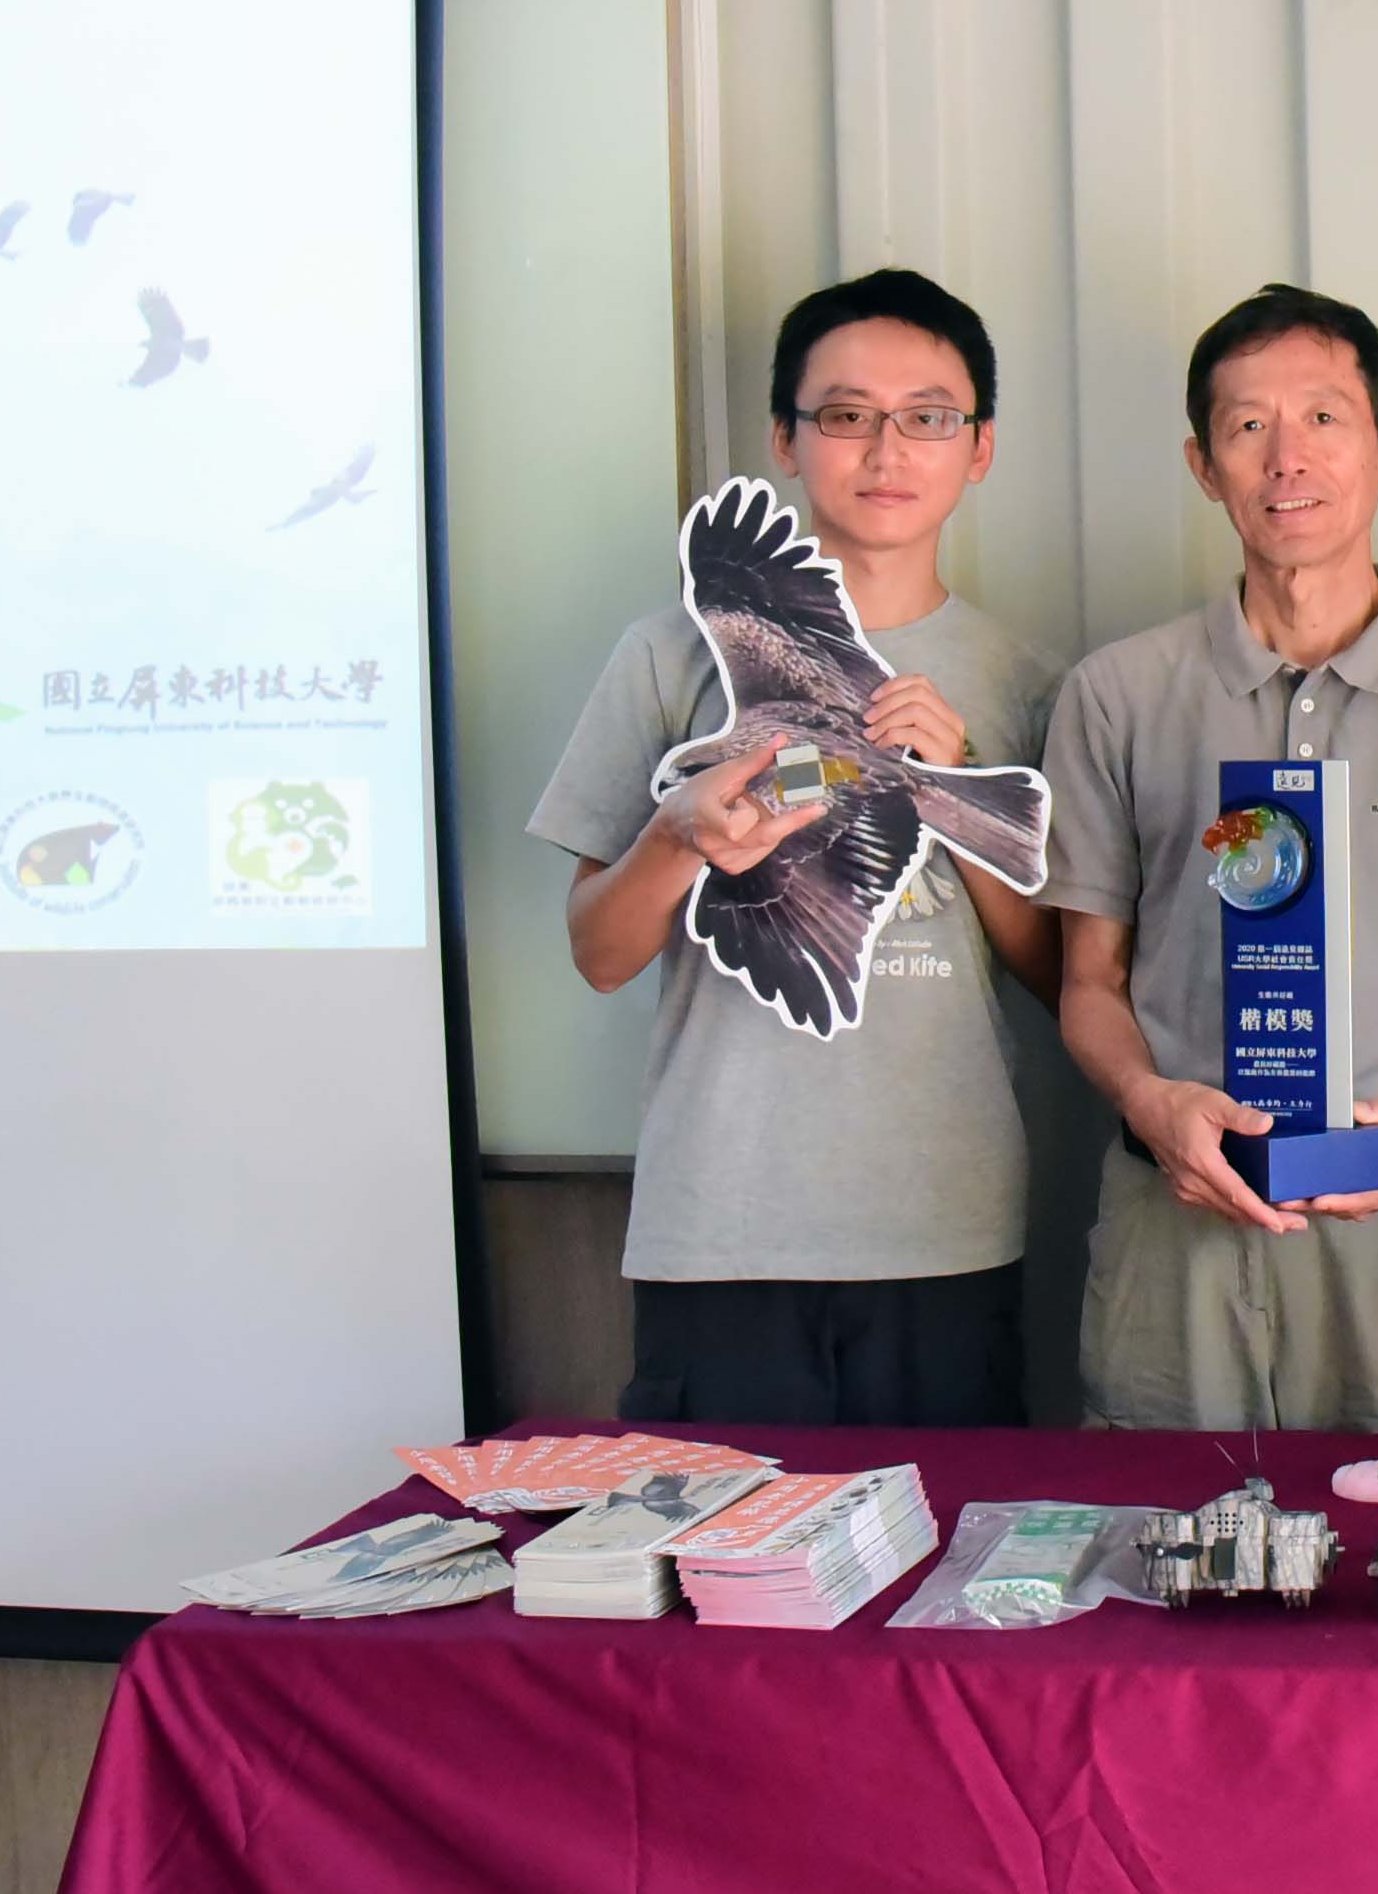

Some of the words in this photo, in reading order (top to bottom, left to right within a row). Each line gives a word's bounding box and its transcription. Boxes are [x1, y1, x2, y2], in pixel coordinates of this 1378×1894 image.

[43, 659, 384, 720] 國立屏東科技大學
[1237, 944, 1256, 953] 2020
[872, 954, 904, 977] ed
[1240, 1007, 1314, 1032] 楷模獎
[1235, 1046, 1317, 1059] 國立屏東科技大學
